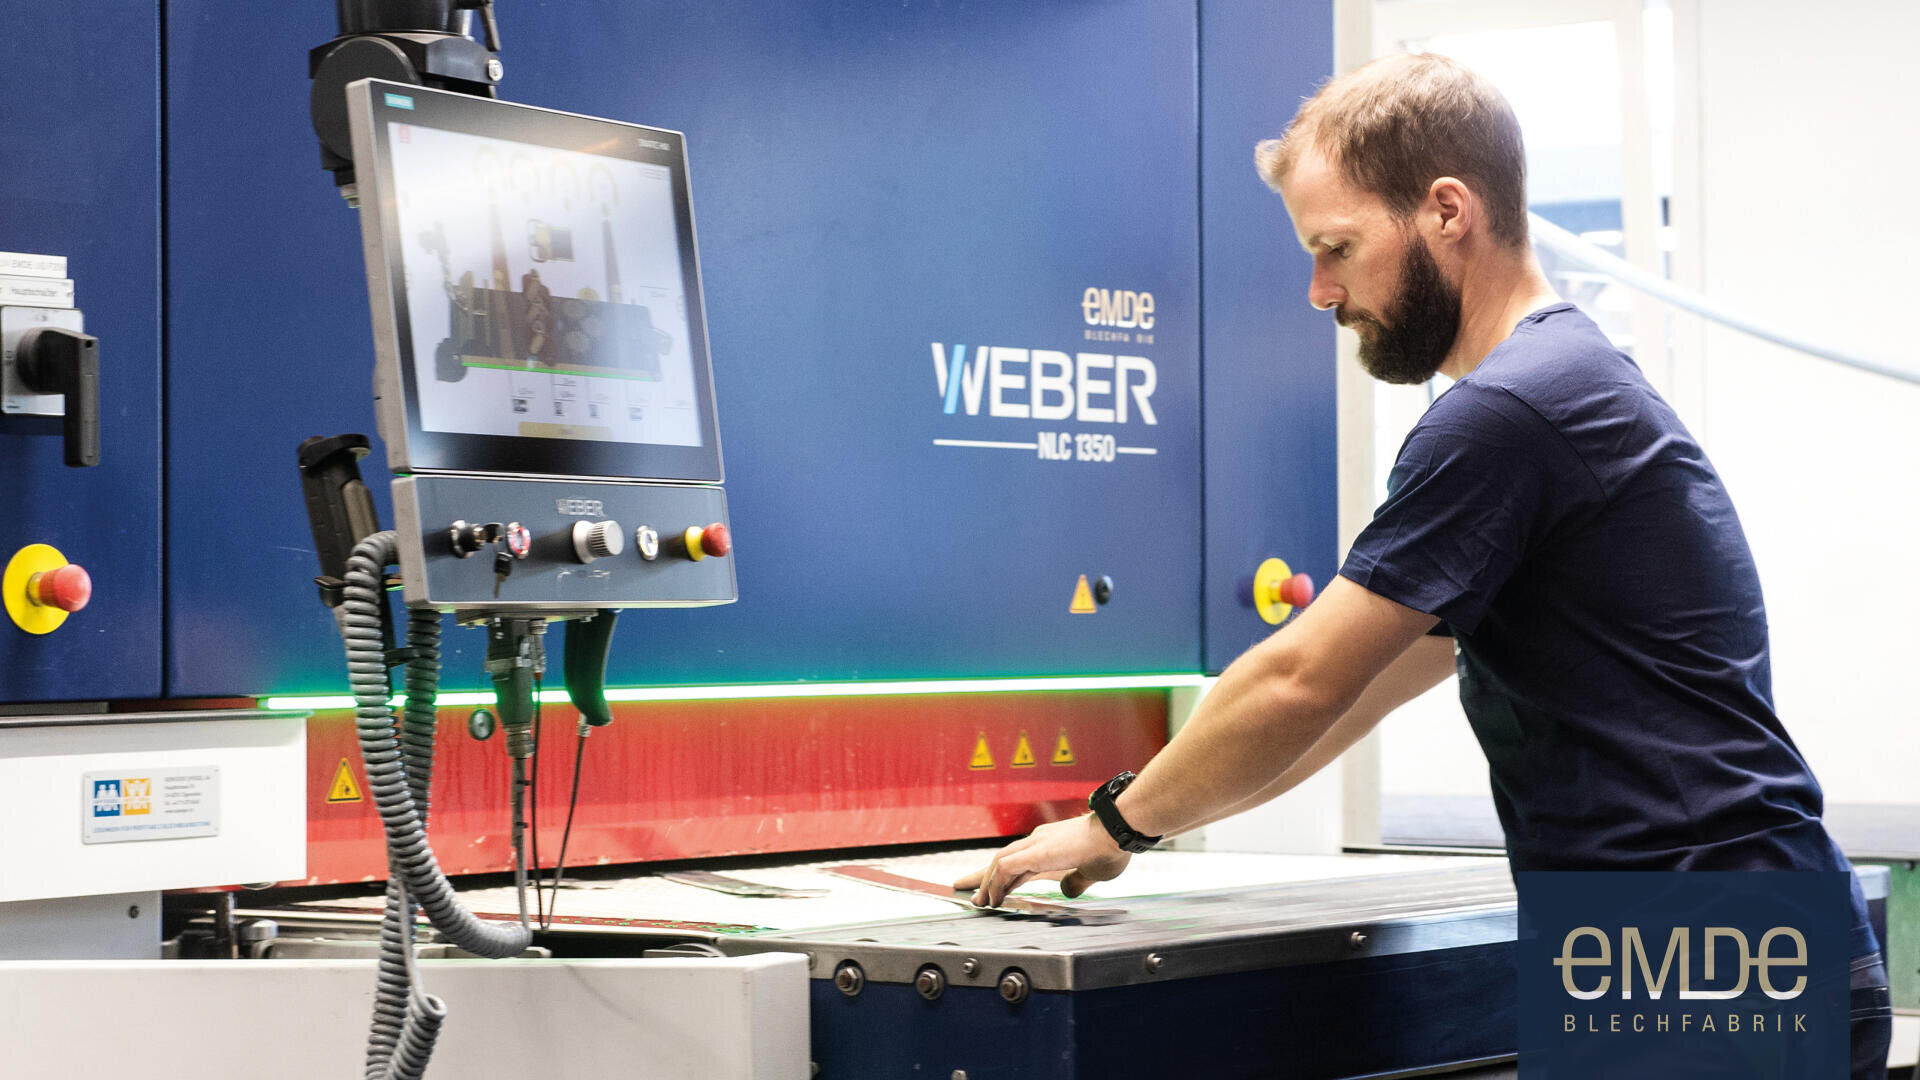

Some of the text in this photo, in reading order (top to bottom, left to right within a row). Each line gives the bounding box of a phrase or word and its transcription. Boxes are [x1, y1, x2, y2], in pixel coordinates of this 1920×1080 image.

[931, 342, 1158, 425] WEBER
[1037, 432, 1116, 463] NLC 1350
